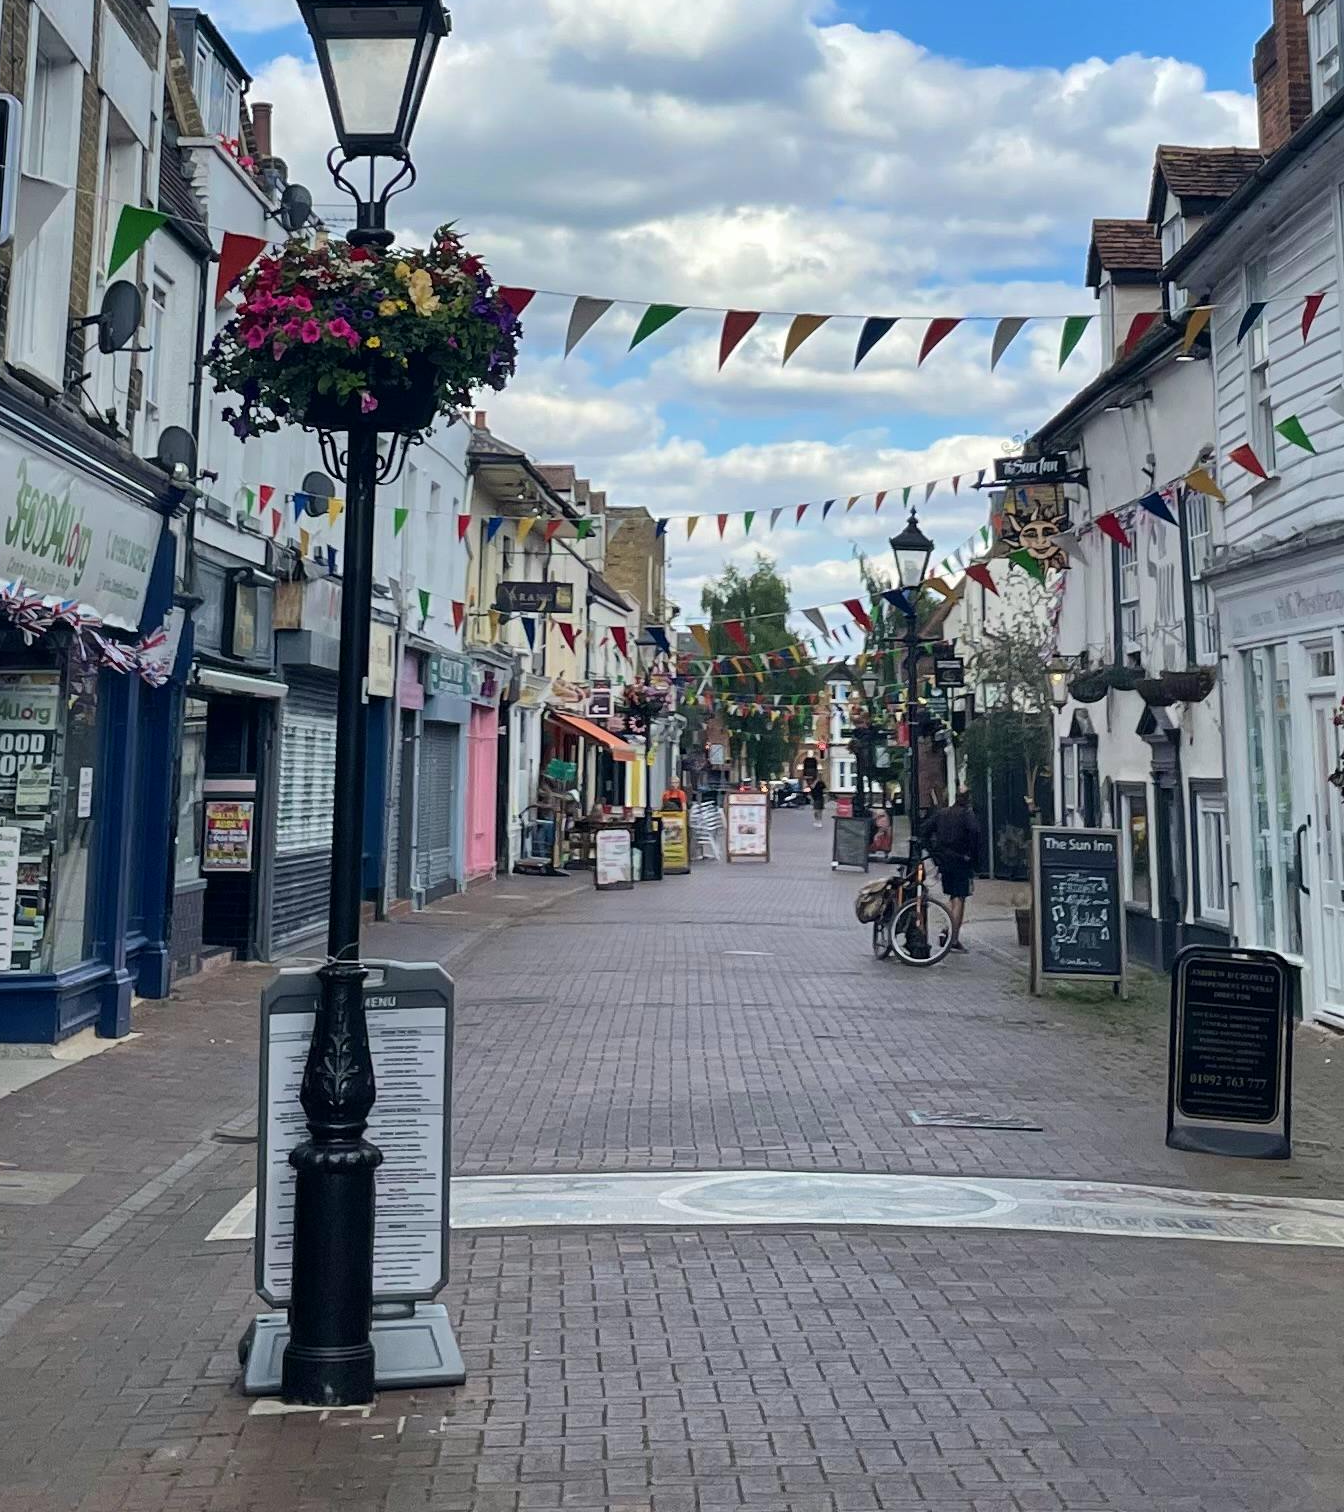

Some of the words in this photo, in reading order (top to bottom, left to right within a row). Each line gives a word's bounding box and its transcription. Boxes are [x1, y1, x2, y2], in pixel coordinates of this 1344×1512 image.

[1014, 458, 1038, 475] Sun
[1038, 456, 1059, 475] Inn
[1044, 838, 1067, 850] The
[1068, 838, 1092, 851] Sun
[1093, 840, 1113, 852] Inn
[1189, 1073, 1223, 1086] 01992
[1226, 1076, 1245, 1088] 763
[1247, 1079, 1268, 1090] 777
